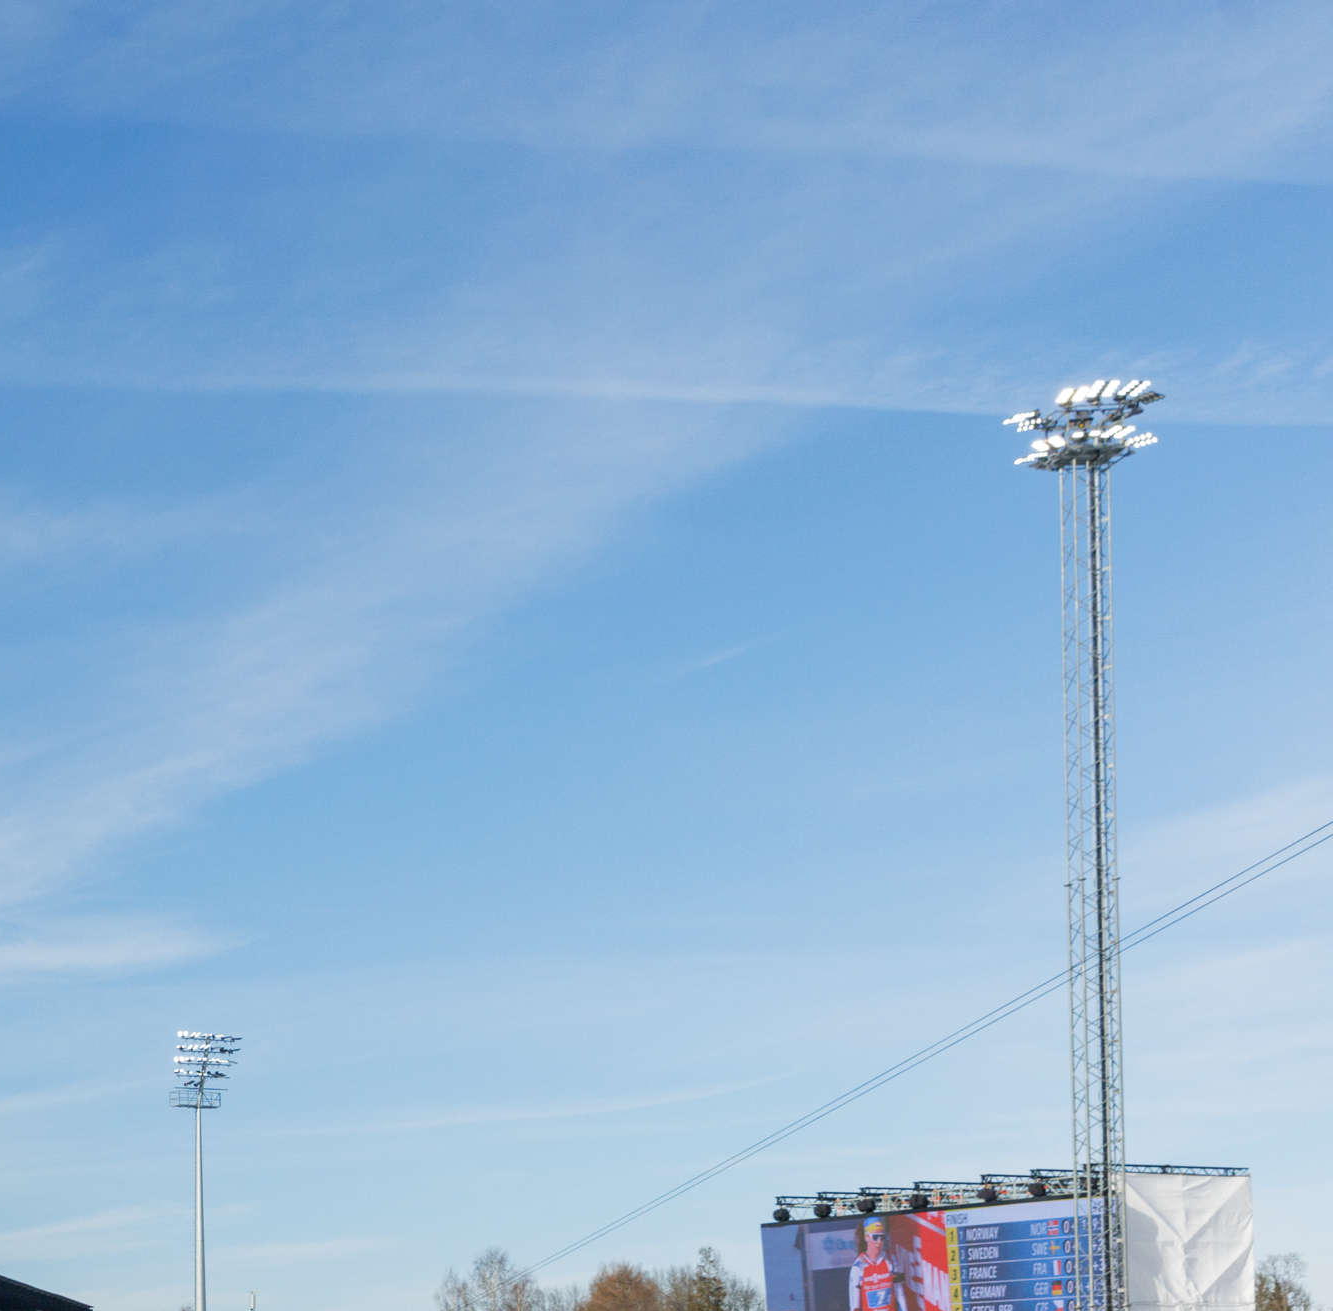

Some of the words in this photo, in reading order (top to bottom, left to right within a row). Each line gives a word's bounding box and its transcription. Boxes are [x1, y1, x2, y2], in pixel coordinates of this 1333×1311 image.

[946, 1213, 968, 1225] FINISH
[966, 1227, 1000, 1241] NORWAY
[1030, 1223, 1047, 1236] NOR
[967, 1247, 999, 1261] SWEDEN
[1032, 1243, 1049, 1256] SWE
[968, 1266, 998, 1280] FRANCE
[1033, 1262, 1047, 1275] FRA
[969, 1285, 1007, 1300] GERMANY
[1034, 1282, 1049, 1296] GER
